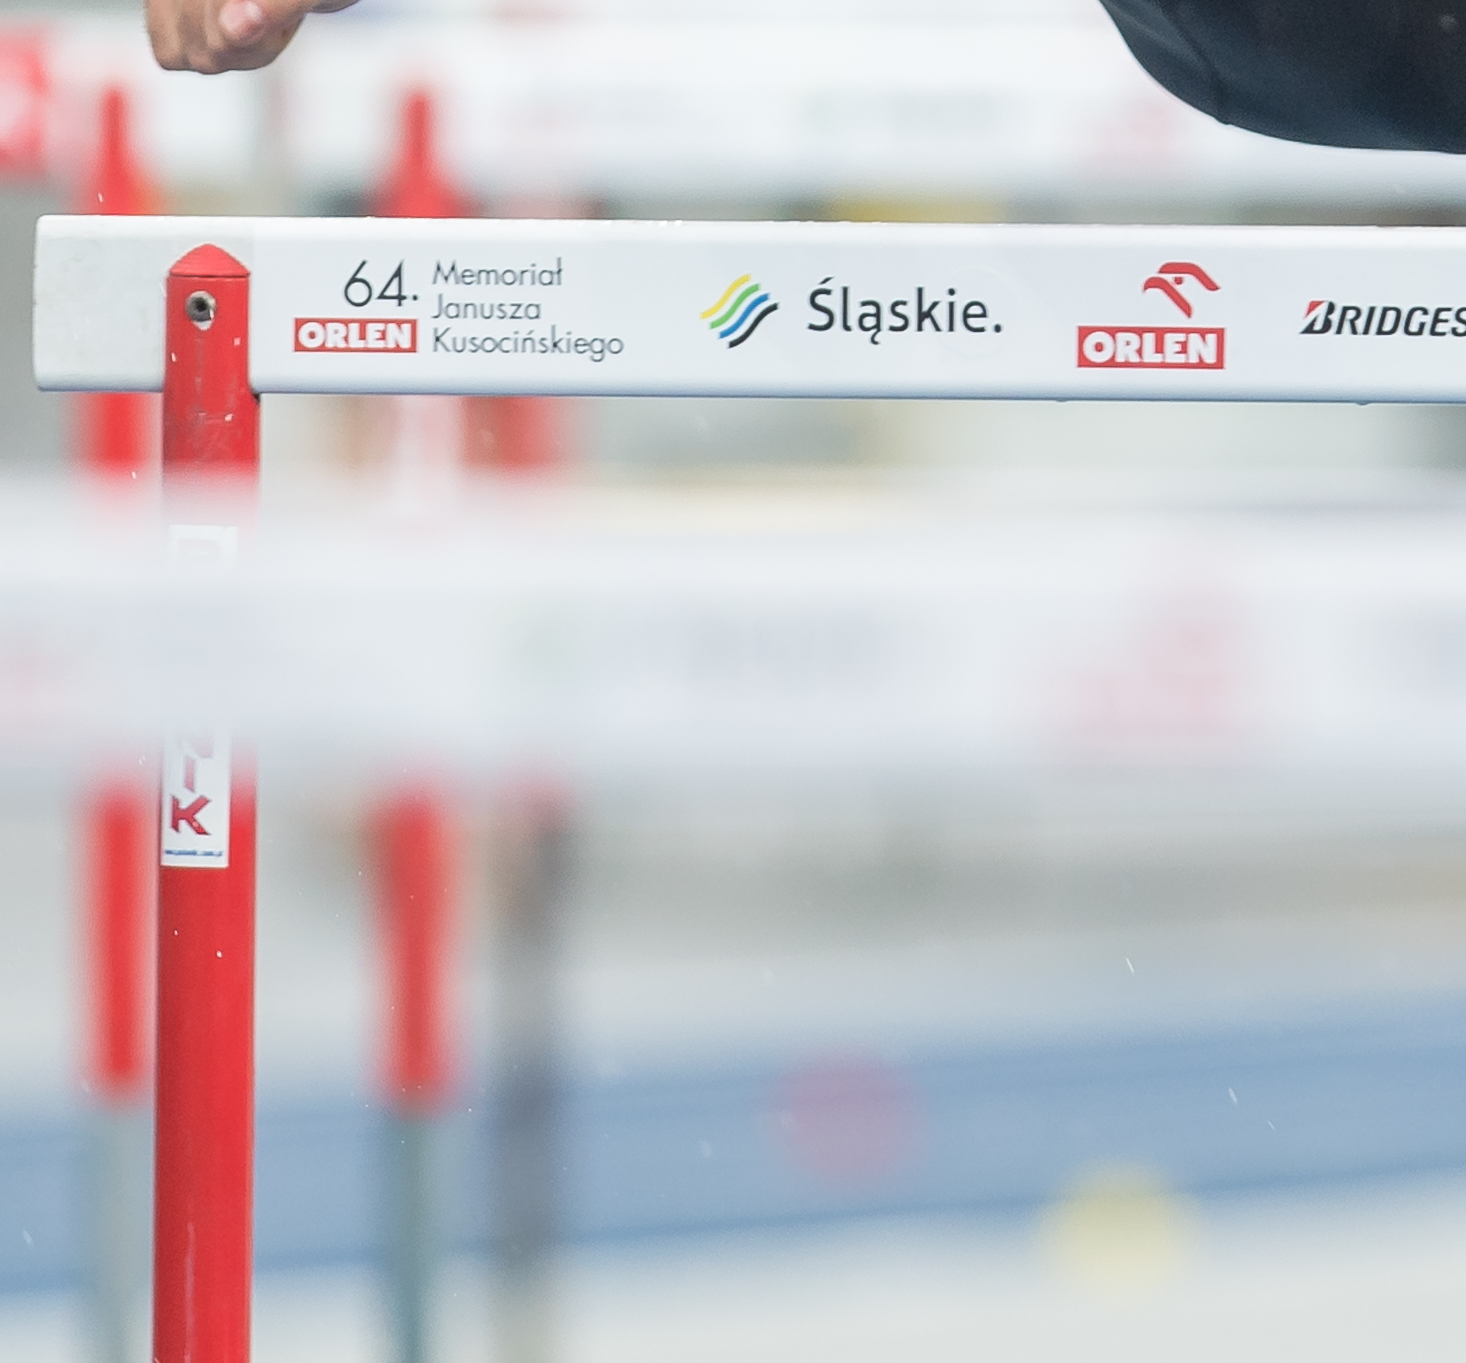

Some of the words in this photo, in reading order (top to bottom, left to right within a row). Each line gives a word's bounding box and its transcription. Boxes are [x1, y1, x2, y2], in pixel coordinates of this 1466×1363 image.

[343, 259, 419, 307] 64.
[431, 257, 563, 286] Memoriał
[430, 293, 542, 320] Janusza
[806, 276, 1004, 345] Śląskie.
[297, 322, 412, 349] ORLEN
[431, 324, 624, 362] Kusocińskiego
[1082, 332, 1218, 364] ORLEN
